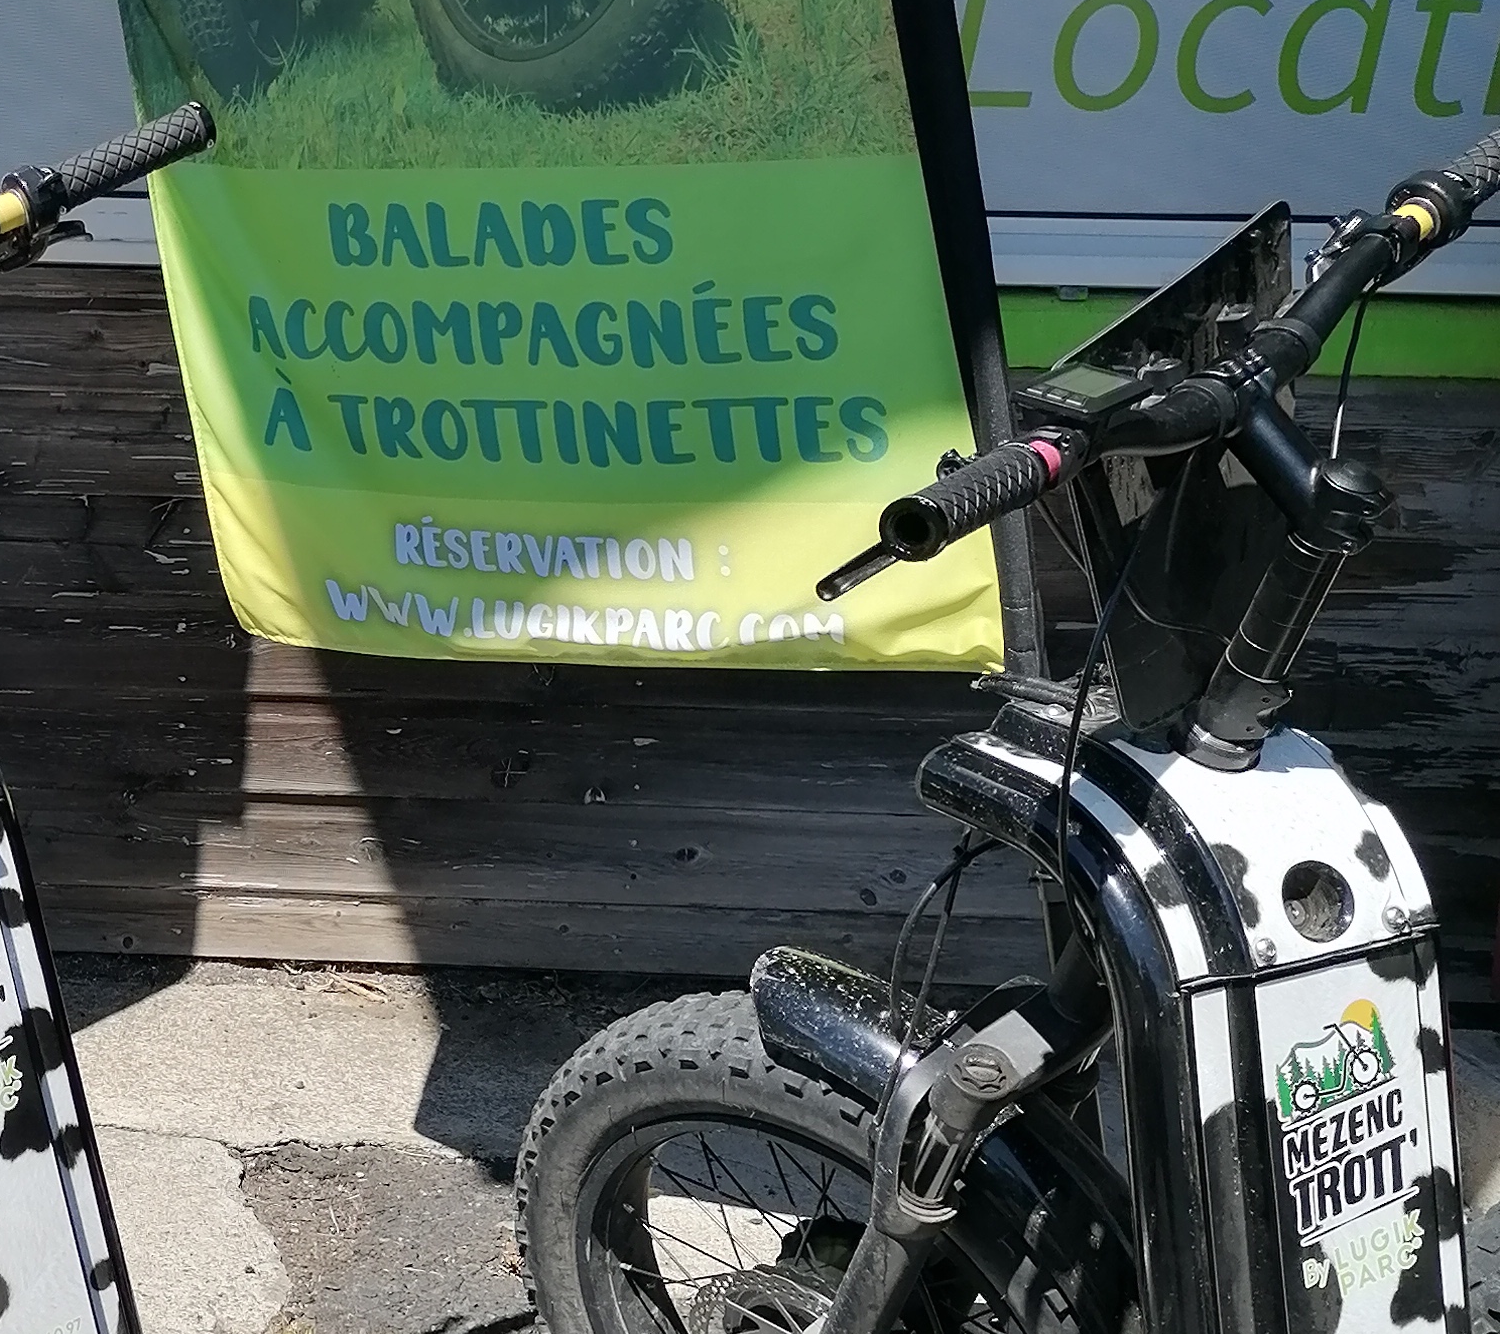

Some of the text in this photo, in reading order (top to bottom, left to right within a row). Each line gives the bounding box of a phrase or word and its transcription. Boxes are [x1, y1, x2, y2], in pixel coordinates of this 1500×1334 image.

[328, 198, 673, 268] BALADES
[248, 280, 838, 369] ACCOMPAGNÉES
[265, 367, 888, 468] À TROTTINETTES
[394, 515, 695, 583] RÉSERVATION
[1286, 1088, 1403, 1175] MEZENC
[1293, 1127, 1418, 1231] TROTT'
[1302, 1209, 1425, 1289] By LUGIK
